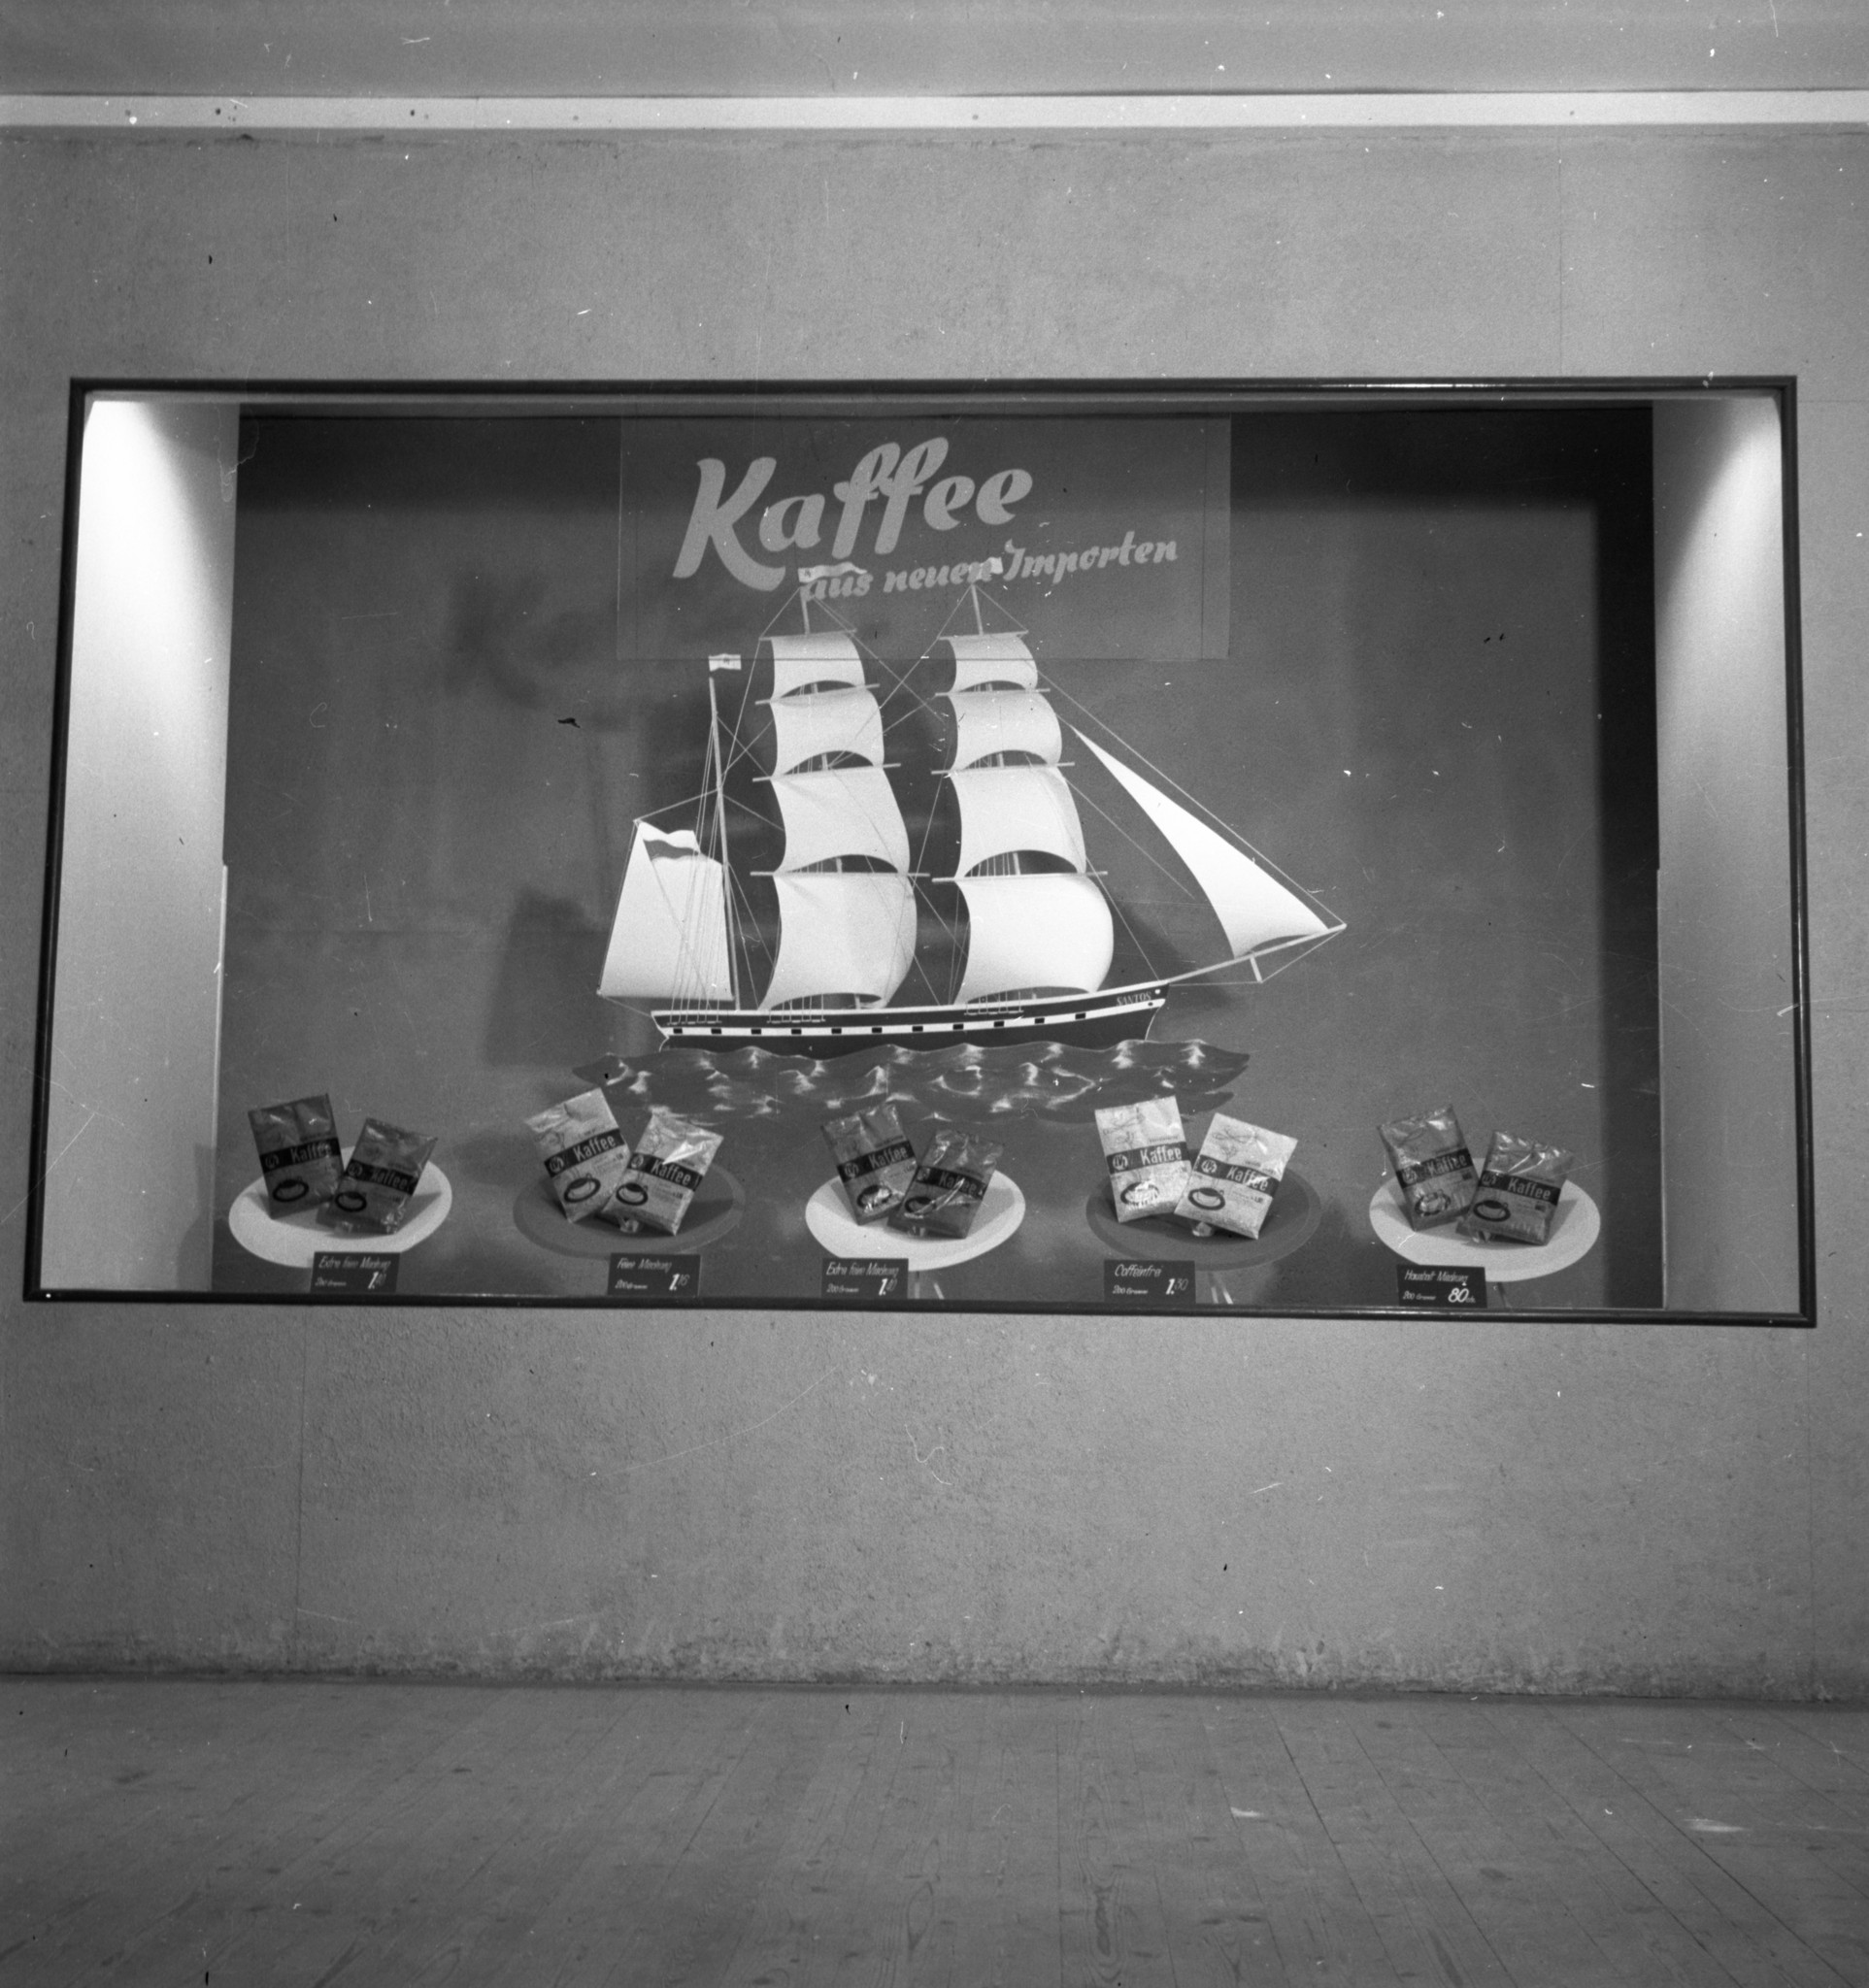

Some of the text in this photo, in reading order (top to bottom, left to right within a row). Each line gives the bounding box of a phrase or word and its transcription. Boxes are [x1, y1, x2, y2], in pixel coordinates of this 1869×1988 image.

[672, 437, 1033, 591] Kaffee
[804, 572, 874, 601] aus
[1003, 531, 1178, 583] Importen
[1117, 992, 1151, 1006] SANTOS
[290, 1141, 332, 1163] Kaffee
[574, 1135, 616, 1162] Kaffee
[869, 1145, 908, 1168] Kaffee
[1139, 1144, 1182, 1166] Kaffee
[651, 1159, 691, 1186] Kaffee
[1428, 1153, 1467, 1176] Kaffee
[371, 1169, 410, 1191] Kaffee
[1226, 1166, 1268, 1192] Kaffee
[1507, 1177, 1552, 1200] Kaffee
[825, 1262, 848, 1276] Extra
[1448, 1287, 1469, 1304] 80
